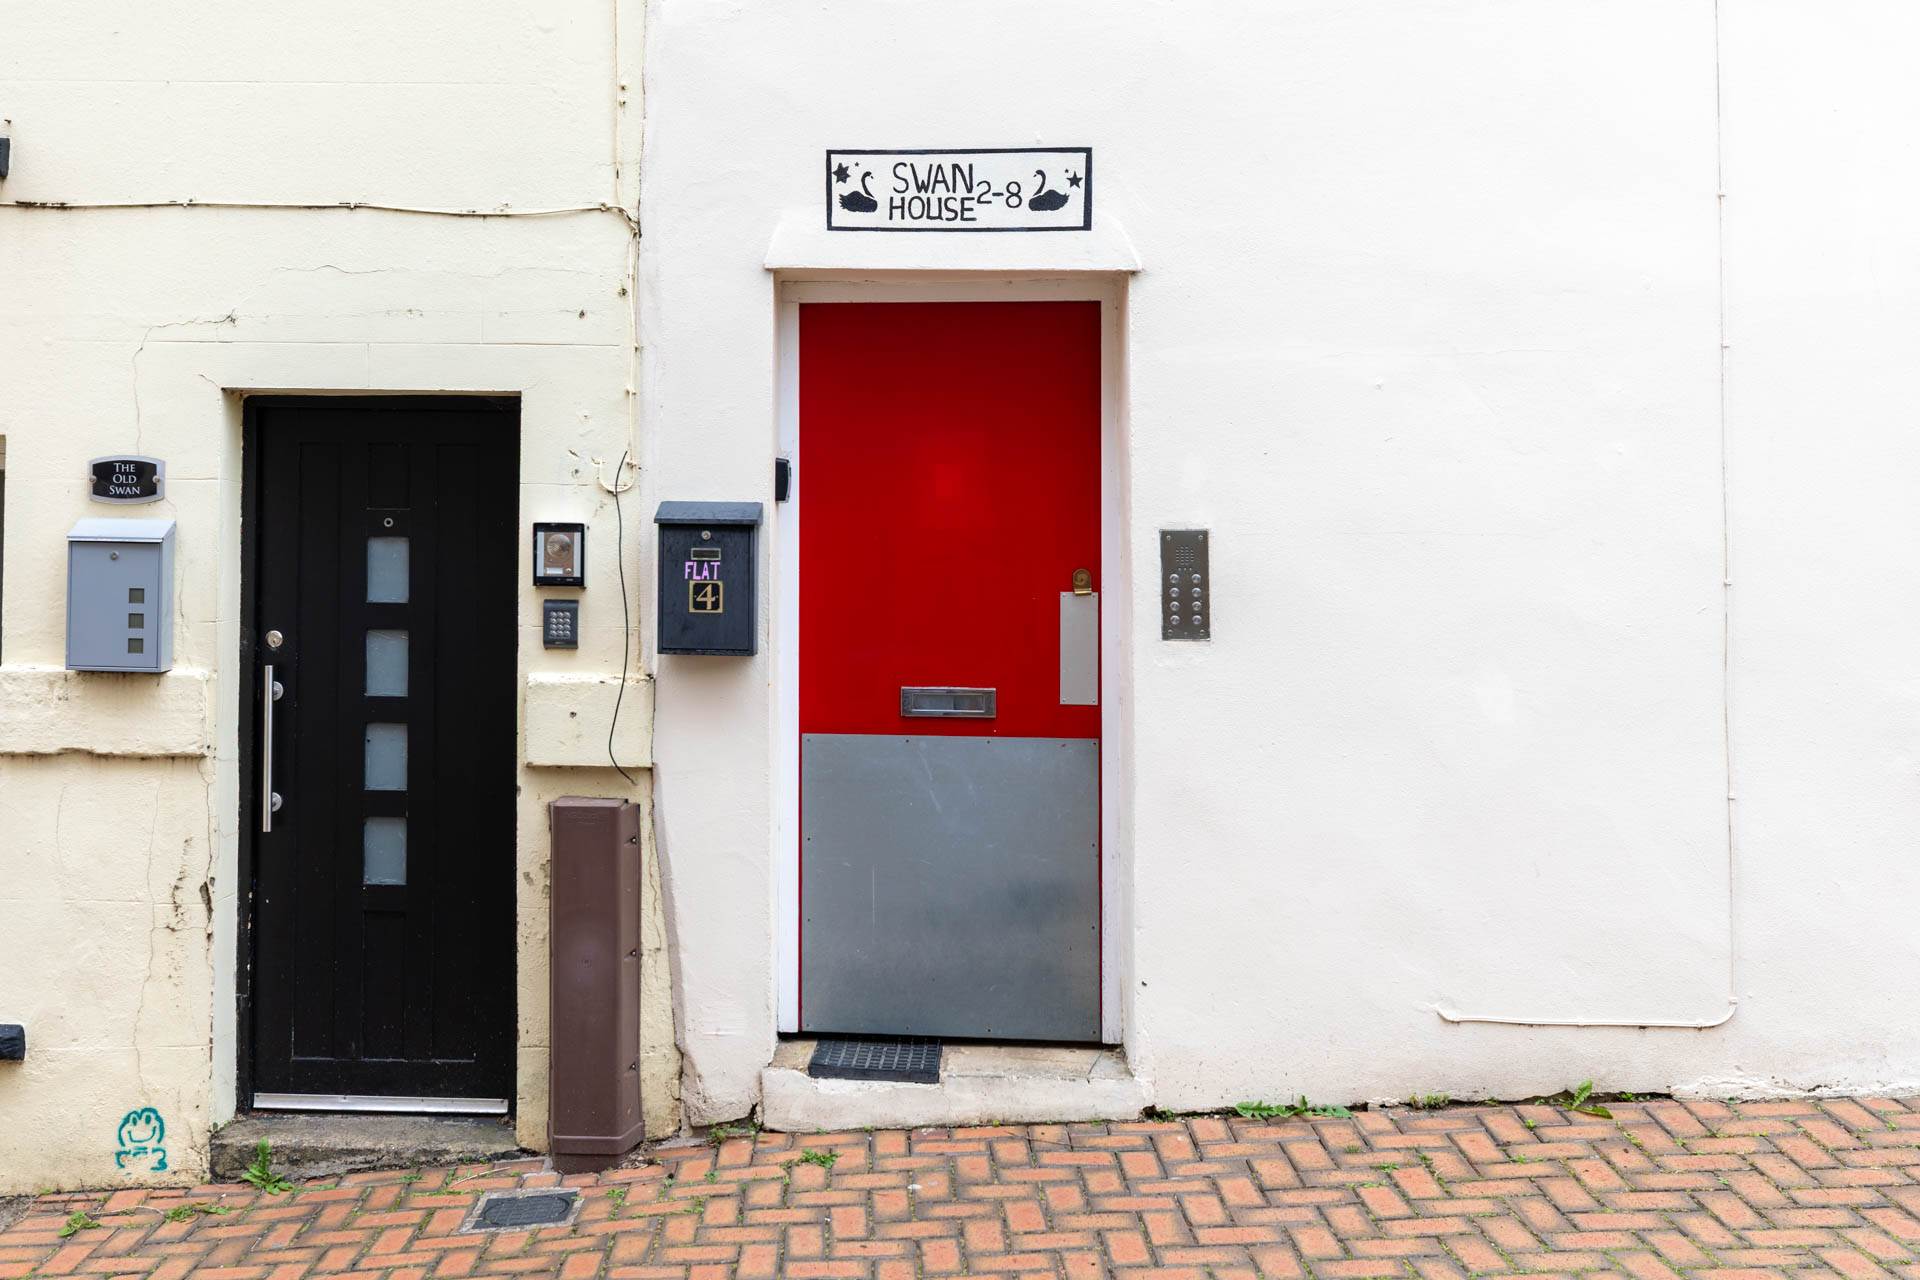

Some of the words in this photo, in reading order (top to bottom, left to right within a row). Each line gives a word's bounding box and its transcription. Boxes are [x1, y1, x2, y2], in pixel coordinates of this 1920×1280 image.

[892, 162, 974, 194] SWAN
[976, 180, 1023, 209] 2-8
[888, 195, 977, 222] HOUSE
[112, 473, 137, 484] OLD
[113, 462, 136, 473] THE
[109, 485, 141, 495] SWAN
[684, 561, 721, 580] FLAT
[695, 583, 716, 610] 4
